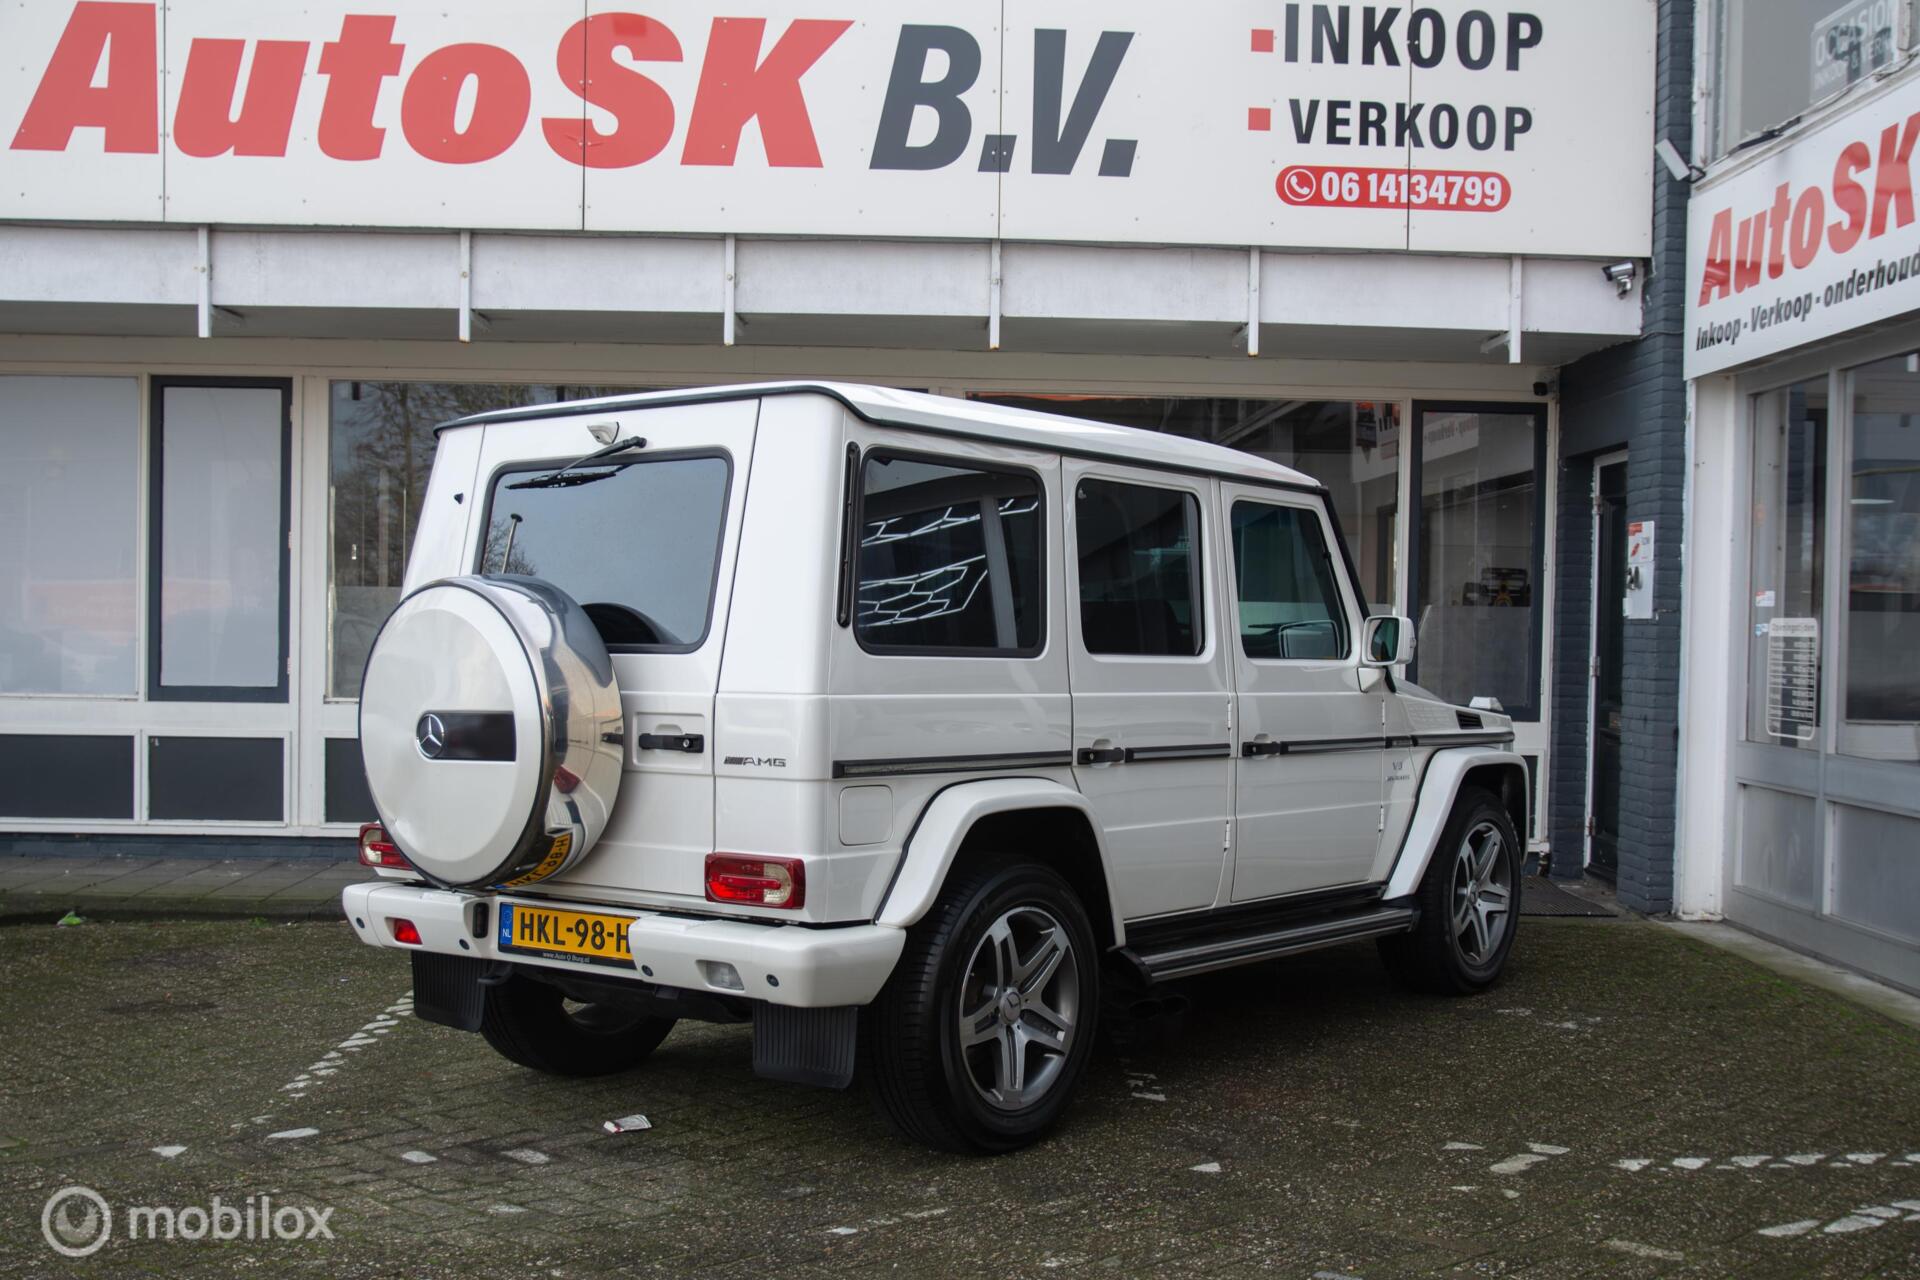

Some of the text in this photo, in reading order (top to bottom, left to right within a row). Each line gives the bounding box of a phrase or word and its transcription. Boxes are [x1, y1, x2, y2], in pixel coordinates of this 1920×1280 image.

[1284, 3, 1544, 72] INKOOP
[9, 0, 1138, 177] AutoSK B.V.
[1288, 98, 1533, 152] VERKOOP
[1321, 171, 1502, 206] 06 14134799
[1697, 111, 1920, 308] AutoSK
[1696, 318, 1742, 351] Inkoop
[1750, 292, 1813, 332] Verkoop
[1823, 244, 1920, 307] onderhoud
[743, 757, 787, 768] AMG
[502, 911, 631, 954] NL HKL-98-H
